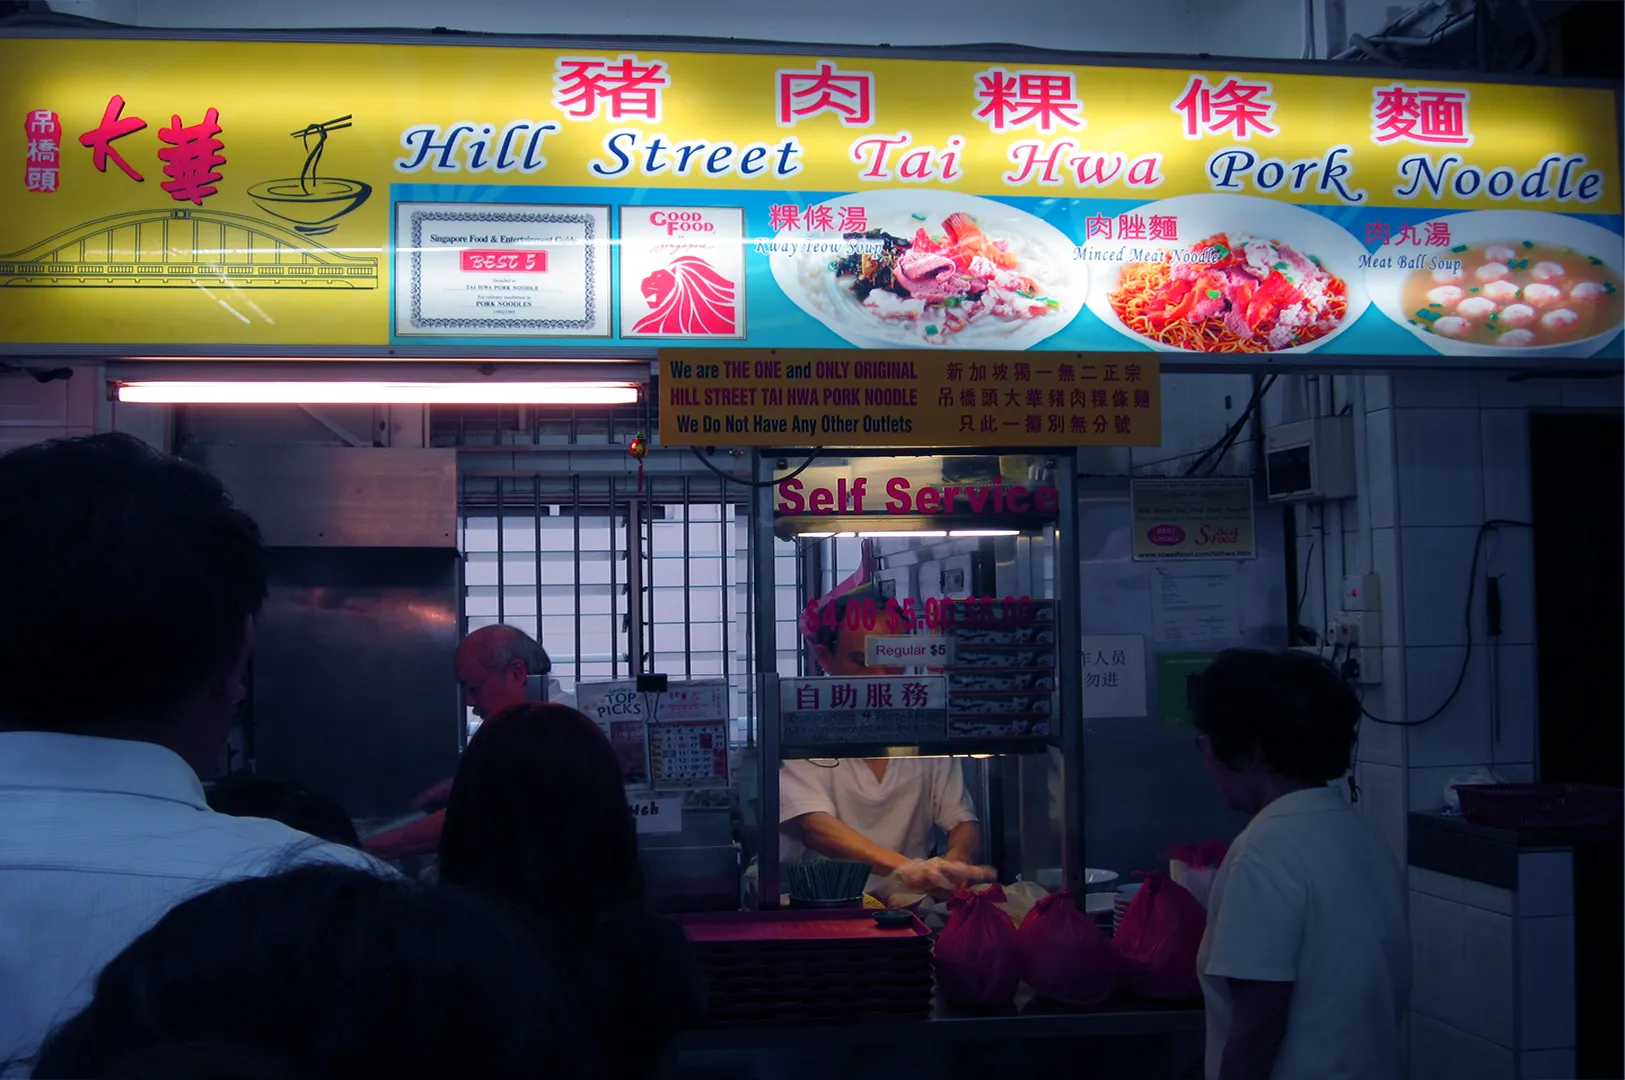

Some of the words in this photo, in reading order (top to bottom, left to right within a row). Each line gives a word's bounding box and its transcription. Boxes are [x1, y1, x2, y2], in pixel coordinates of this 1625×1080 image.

[26, 110, 60, 191] 吊橋頭
[78, 94, 227, 206] 大華
[399, 123, 557, 171] Hill
[593, 131, 801, 175] Street
[854, 135, 965, 178] Tai
[1007, 142, 1160, 186] Hwa
[1209, 148, 1364, 201] Pork
[1397, 156, 1601, 200] Noodle
[649, 210, 703, 227] GOOD
[769, 204, 869, 232] 粿條湯
[667, 221, 715, 236] FOOD
[1364, 219, 1452, 247] 肉丸湯
[430, 233, 468, 245] Singapore
[469, 234, 489, 244] Food
[490, 235, 498, 244] &
[756, 237, 798, 257] Kway
[803, 238, 841, 253] Teow
[846, 239, 883, 258] Soup
[469, 253, 520, 270] BEST
[525, 253, 537, 270] 5
[1072, 246, 1127, 262] Minced
[1129, 248, 1165, 262] Meat
[1170, 247, 1220, 263] Noodle
[1359, 254, 1393, 269] Meat
[1397, 254, 1428, 269] Ball
[1429, 256, 1462, 274] Soup
[512, 284, 540, 292] NOODLE
[475, 300, 496, 308] PORK
[670, 360, 692, 379] We
[696, 364, 719, 379] are
[723, 360, 750, 379] THE
[754, 360, 782, 379] ONE
[786, 361, 812, 379] and
[816, 360, 850, 379] ONLY
[854, 361, 918, 379] ORIGINAL
[946, 361, 1142, 382] 新加坡獨一無二正宗
[670, 387, 701, 406] HILL
[704, 387, 757, 406] STREET
[761, 387, 783, 406] TAI
[787, 387, 819, 406] HWA
[823, 387, 861, 406] PORK
[865, 387, 918, 406] NOODLE
[677, 414, 699, 433] We
[703, 414, 721, 433] Do
[725, 414, 749, 433] Not
[753, 414, 787, 433] Have
[792, 415, 817, 437] Any
[821, 414, 859, 433] Other
[863, 414, 913, 433] Outlets
[778, 477, 867, 515] Self
[885, 476, 1059, 515] Service
[806, 597, 877, 631] $4.00
[887, 596, 955, 630] $5.00
[876, 644, 926, 659] Regular
[930, 643, 946, 658] $5
[1084, 671, 1120, 687] 勿进
[604, 692, 637, 705] TOP
[796, 682, 929, 710] 自助服務
[597, 703, 642, 718] PICKS
